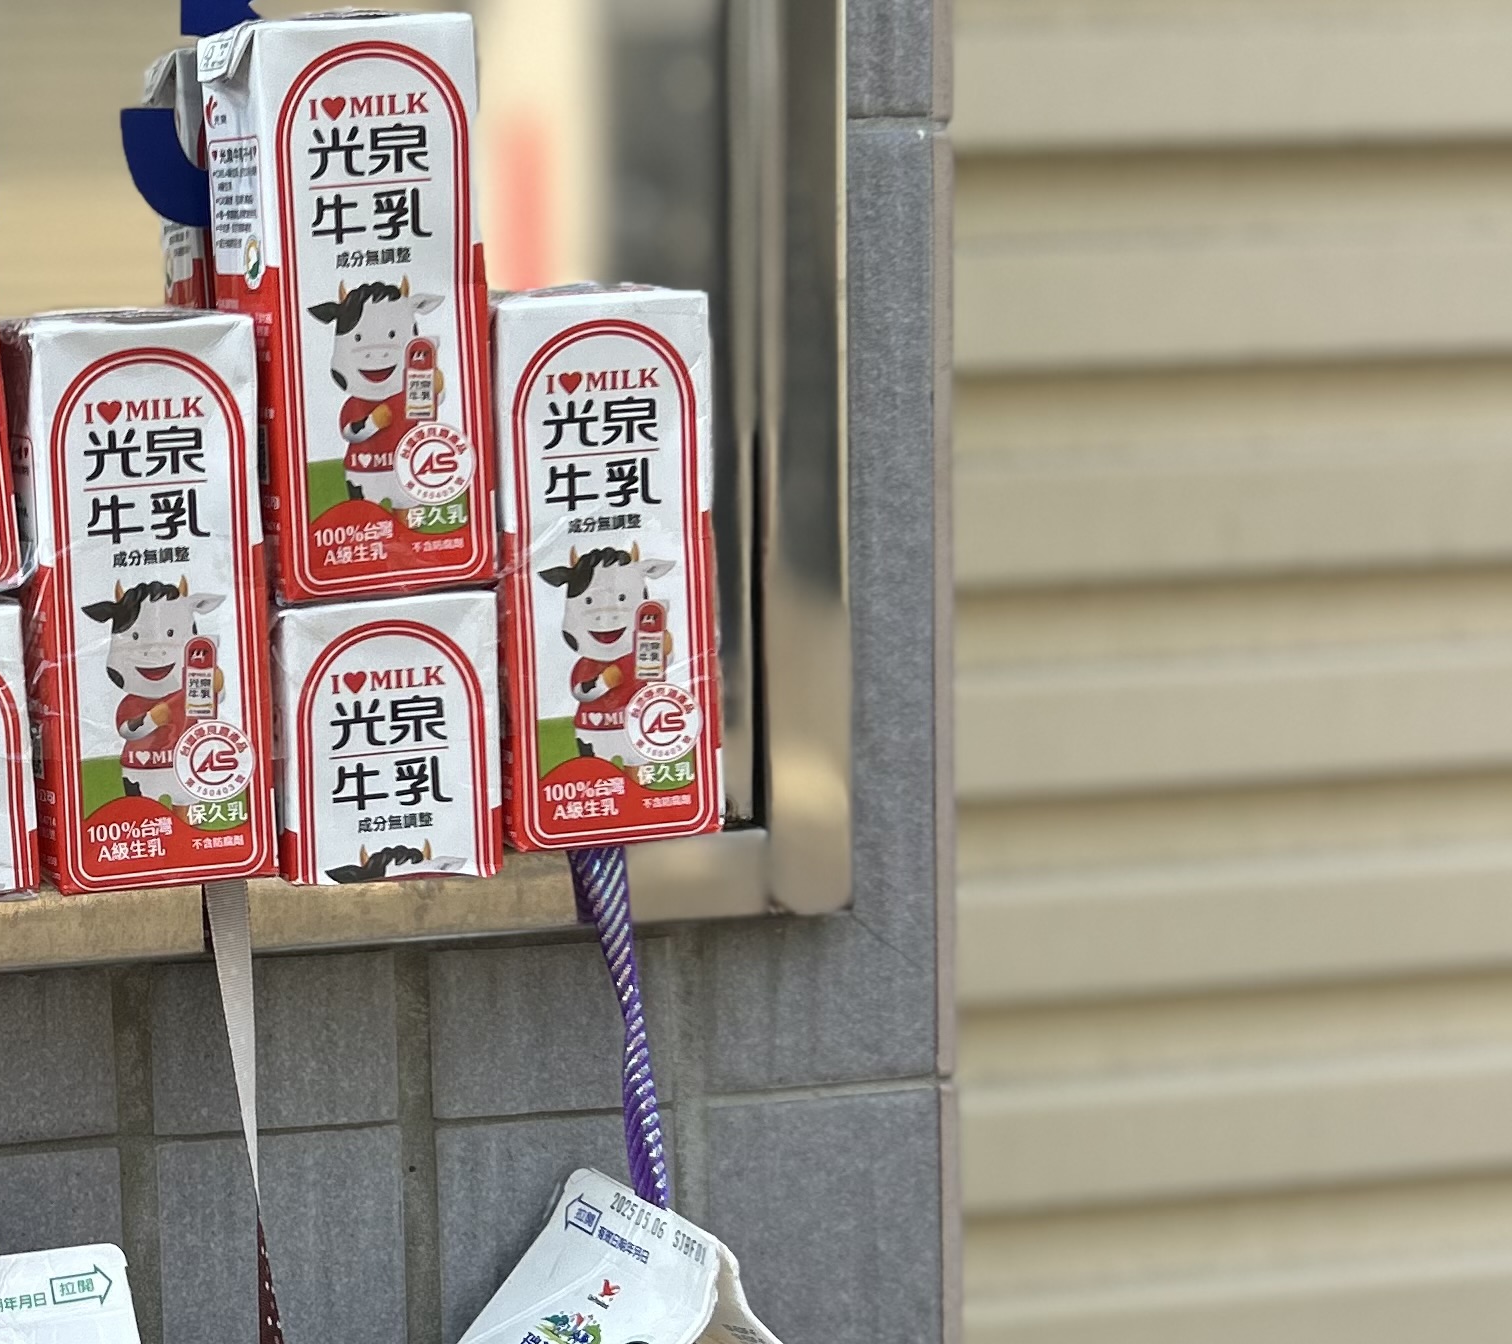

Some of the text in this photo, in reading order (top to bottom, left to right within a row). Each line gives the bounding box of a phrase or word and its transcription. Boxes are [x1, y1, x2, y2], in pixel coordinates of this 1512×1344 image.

[349, 92, 429, 118] MILK
[308, 123, 430, 180] 光泉
[312, 188, 433, 244] 牛乳
[585, 367, 660, 392] MILK
[126, 396, 205, 422] MILK
[543, 396, 658, 450] 光泉
[84, 425, 206, 482] 光泉
[545, 457, 662, 512] 牛乳
[87, 489, 211, 544] 牛乳
[406, 504, 467, 527] 保久乳
[314, 520, 393, 547] 100%台灣
[323, 544, 387, 566] A級生乳
[369, 665, 445, 692] MILK
[330, 695, 447, 751] 光泉
[332, 755, 453, 810] 牛乳
[637, 762, 694, 785] 保久乳
[543, 776, 625, 802] 100%台灣
[186, 801, 248, 825] 保久乳
[553, 798, 619, 821] A級生乳
[87, 816, 173, 843] 100%台灣
[97, 839, 166, 862] A級生乳
[59, 1277, 94, 1296] 拉開
